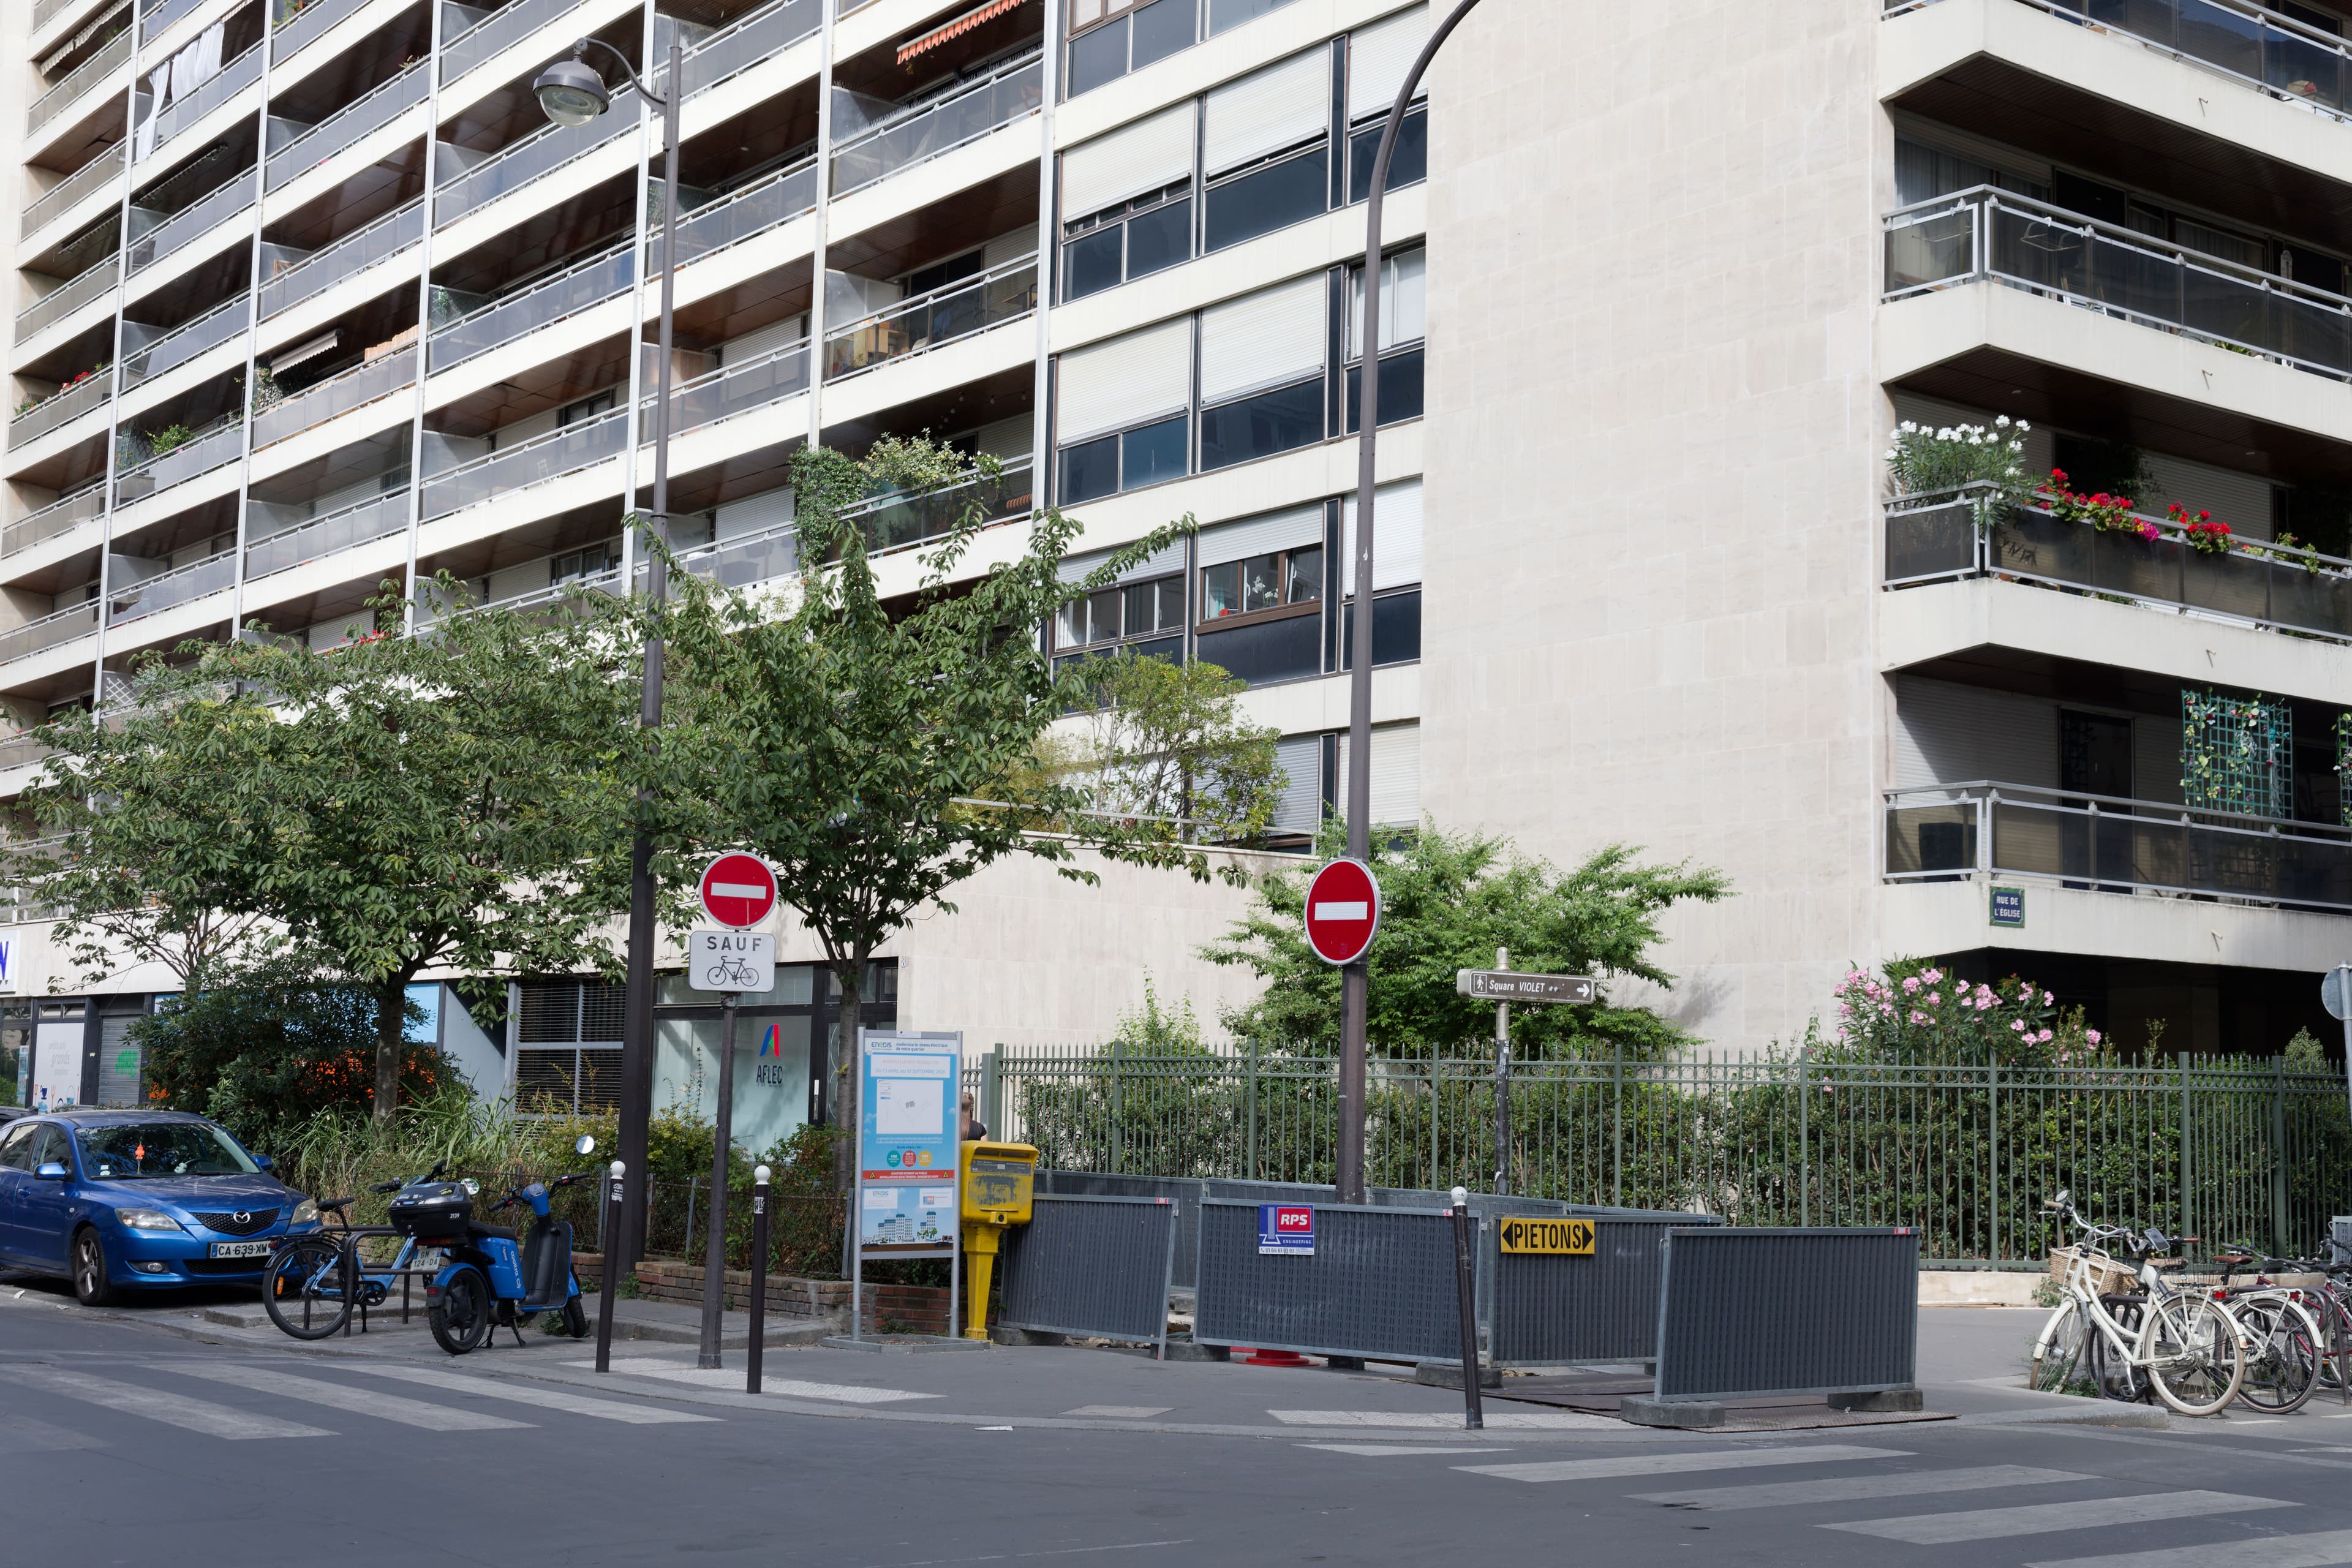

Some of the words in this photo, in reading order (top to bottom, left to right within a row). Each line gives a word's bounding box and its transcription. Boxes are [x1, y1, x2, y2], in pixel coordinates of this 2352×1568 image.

[1996, 896, 2009, 905] RUE
[2010, 897, 2019, 905] DE
[1994, 907, 2021, 918] L'ÉGLISE
[707, 936, 762, 952] SAUF
[1489, 979, 1515, 992] Square
[1519, 981, 1545, 993] VIOLET
[756, 1065, 783, 1084] AFLEC
[1280, 1214, 1308, 1226] RPS
[1513, 1223, 1581, 1249] PIETONS
[510, 1250, 519, 1276] cooltra
